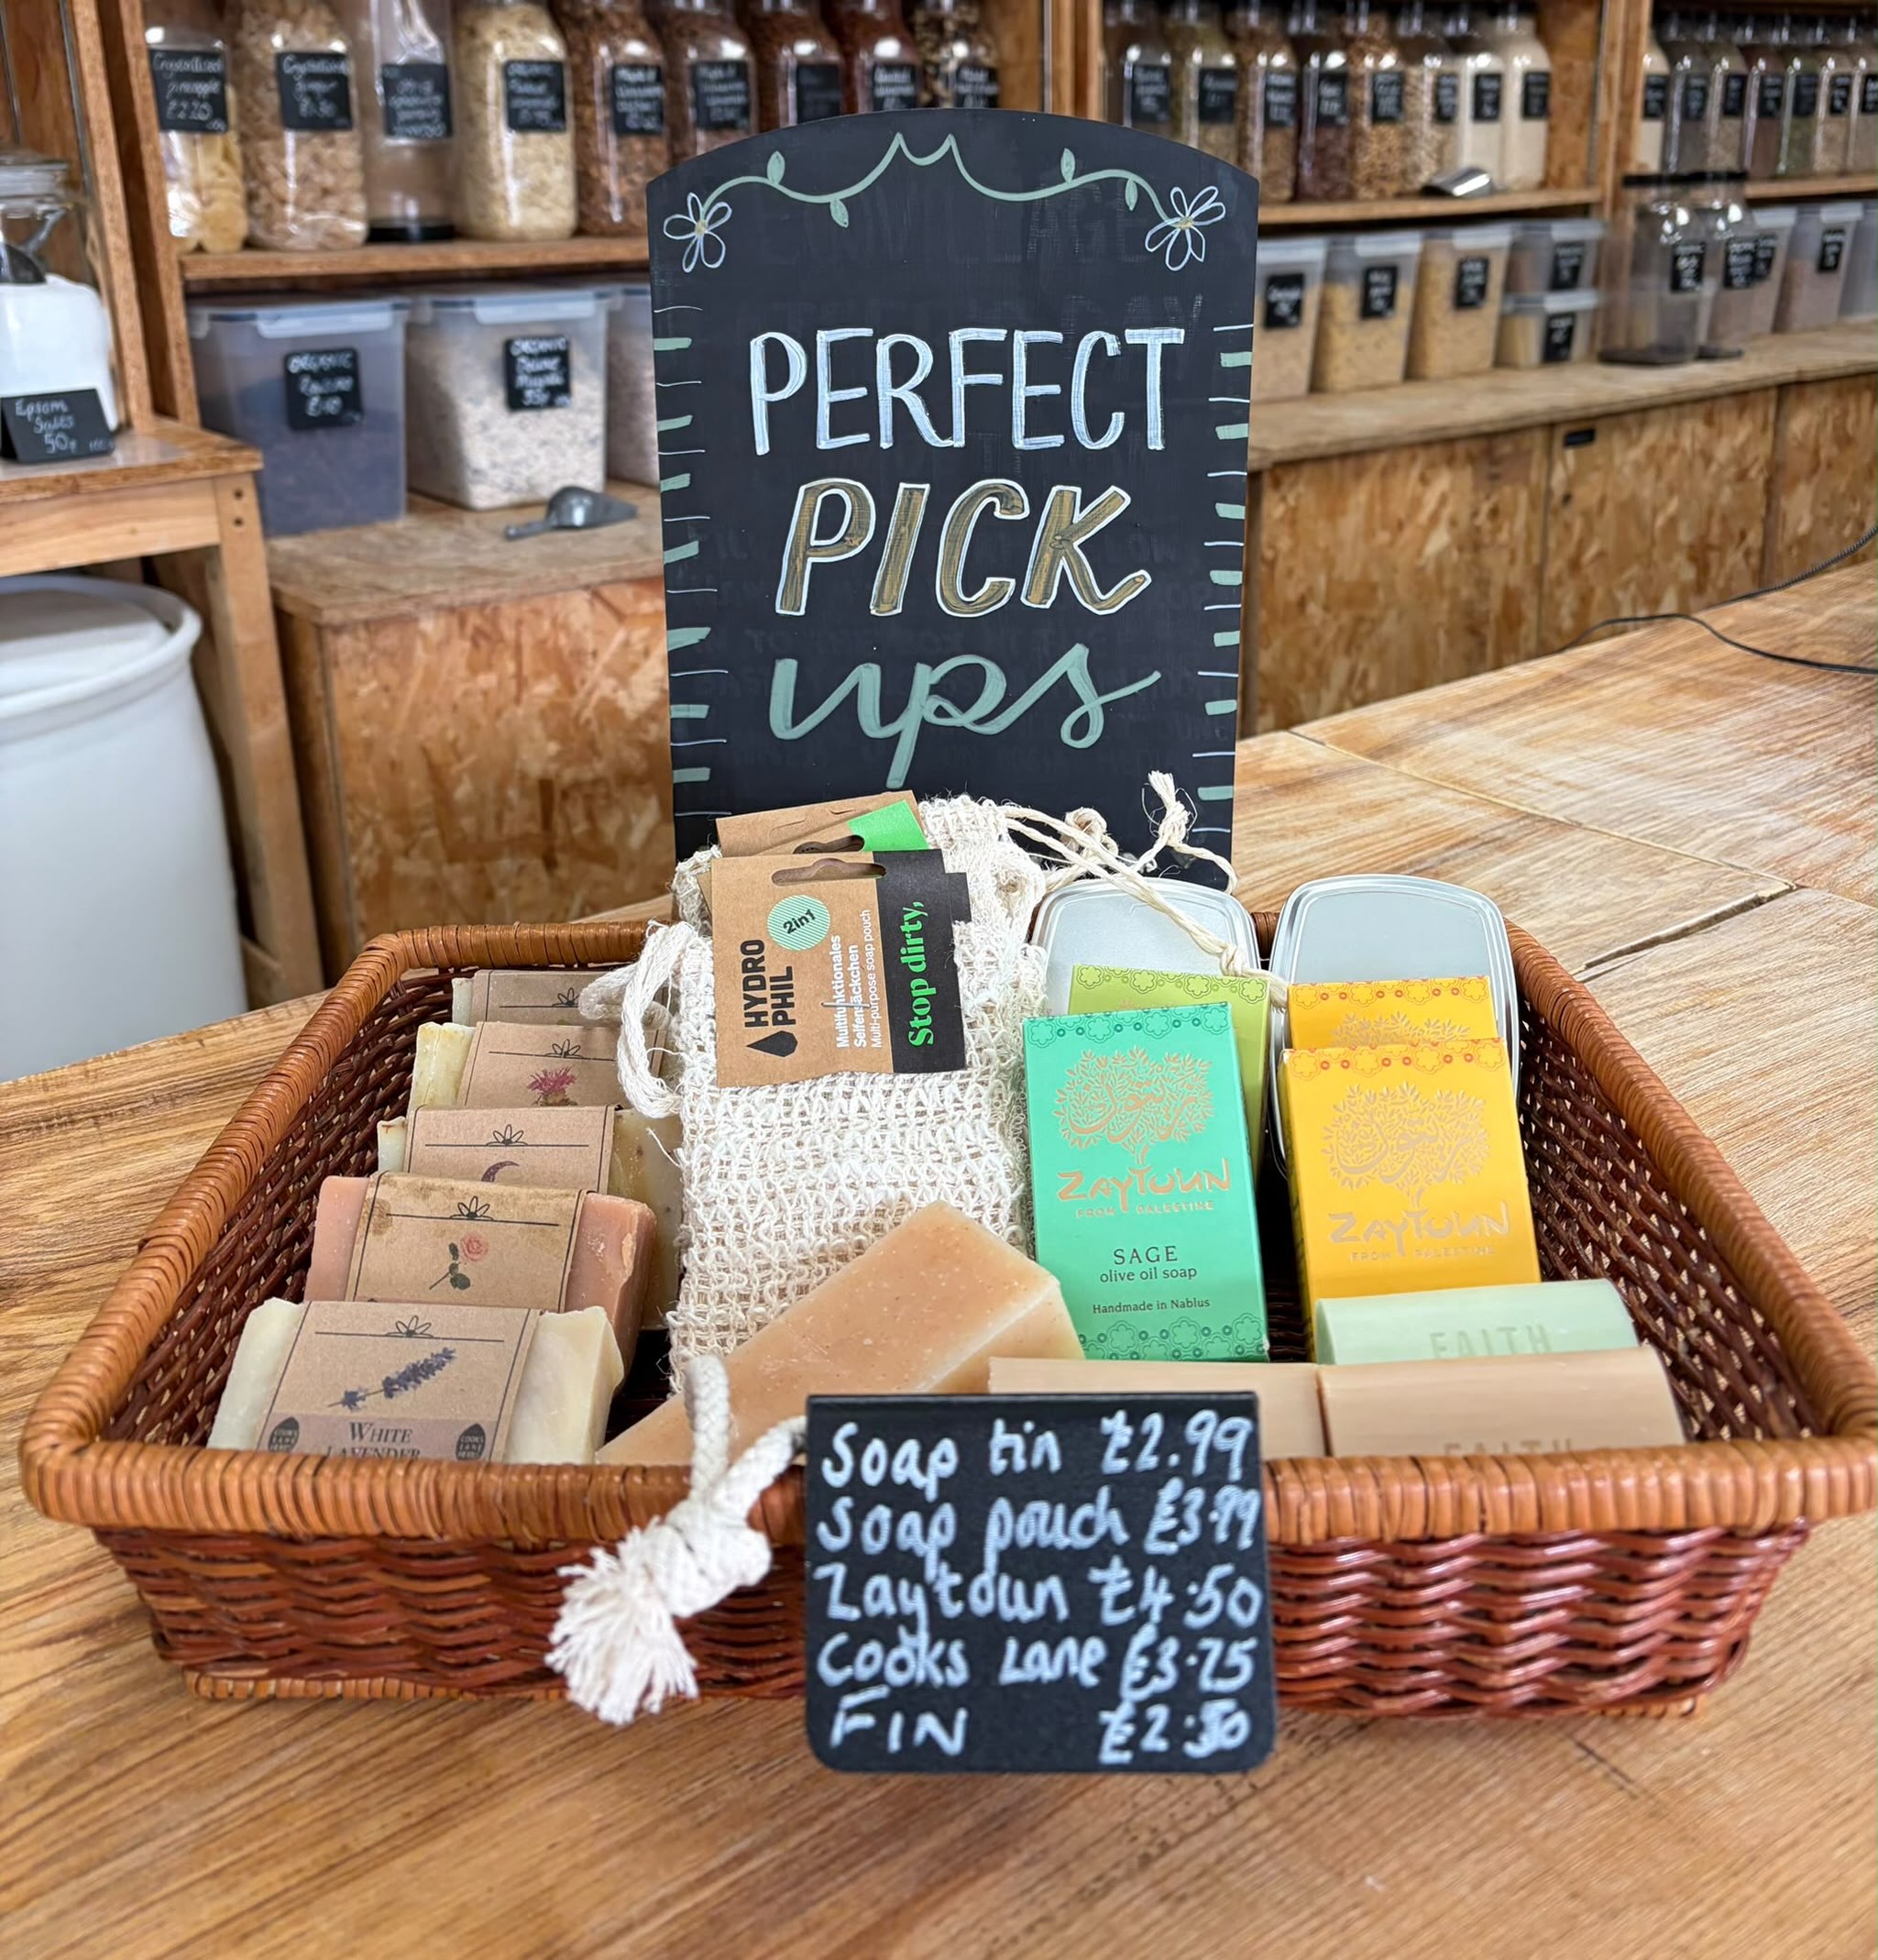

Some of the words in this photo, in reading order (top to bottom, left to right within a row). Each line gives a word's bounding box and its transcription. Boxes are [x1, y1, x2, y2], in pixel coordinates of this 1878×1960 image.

[15, 398, 69, 422] Epsom
[750, 326, 1184, 455] PERFECT
[775, 478, 1152, 618] PICK
[769, 644, 1161, 788] ups
[783, 909, 816, 933] 2in1
[860, 909, 874, 941] pouch
[900, 901, 928, 973] dirty,
[740, 940, 769, 1028] HYDRO
[829, 934, 850, 1048] Multifunktionales
[864, 943, 875, 971] soap
[770, 966, 796, 1027] PHIL
[867, 972, 882, 1048] Multi-purpose
[907, 978, 937, 1047] Stop
[1076, 1207, 1115, 1218] FROM
[1137, 1200, 1214, 1216] PALESTINE
[1100, 1269, 1135, 1283] olive
[1140, 1267, 1158, 1280] oil
[1162, 1266, 1197, 1282] soap
[1113, 1246, 1179, 1265] SAGE
[1093, 1298, 1153, 1314] Handmade
[1157, 1300, 1167, 1310] in
[1170, 1296, 1211, 1309] Nablus
[821, 1421, 959, 1503] Soap
[989, 1417, 1061, 1474] tin
[1100, 1409, 1254, 1481] £2.99
[816, 1496, 957, 1583] Soap
[984, 1484, 1130, 1578] pouch
[812, 1561, 1069, 1647] Zaytoun
[816, 1627, 970, 1689] Cooks
[829, 1684, 969, 1756] FIN
